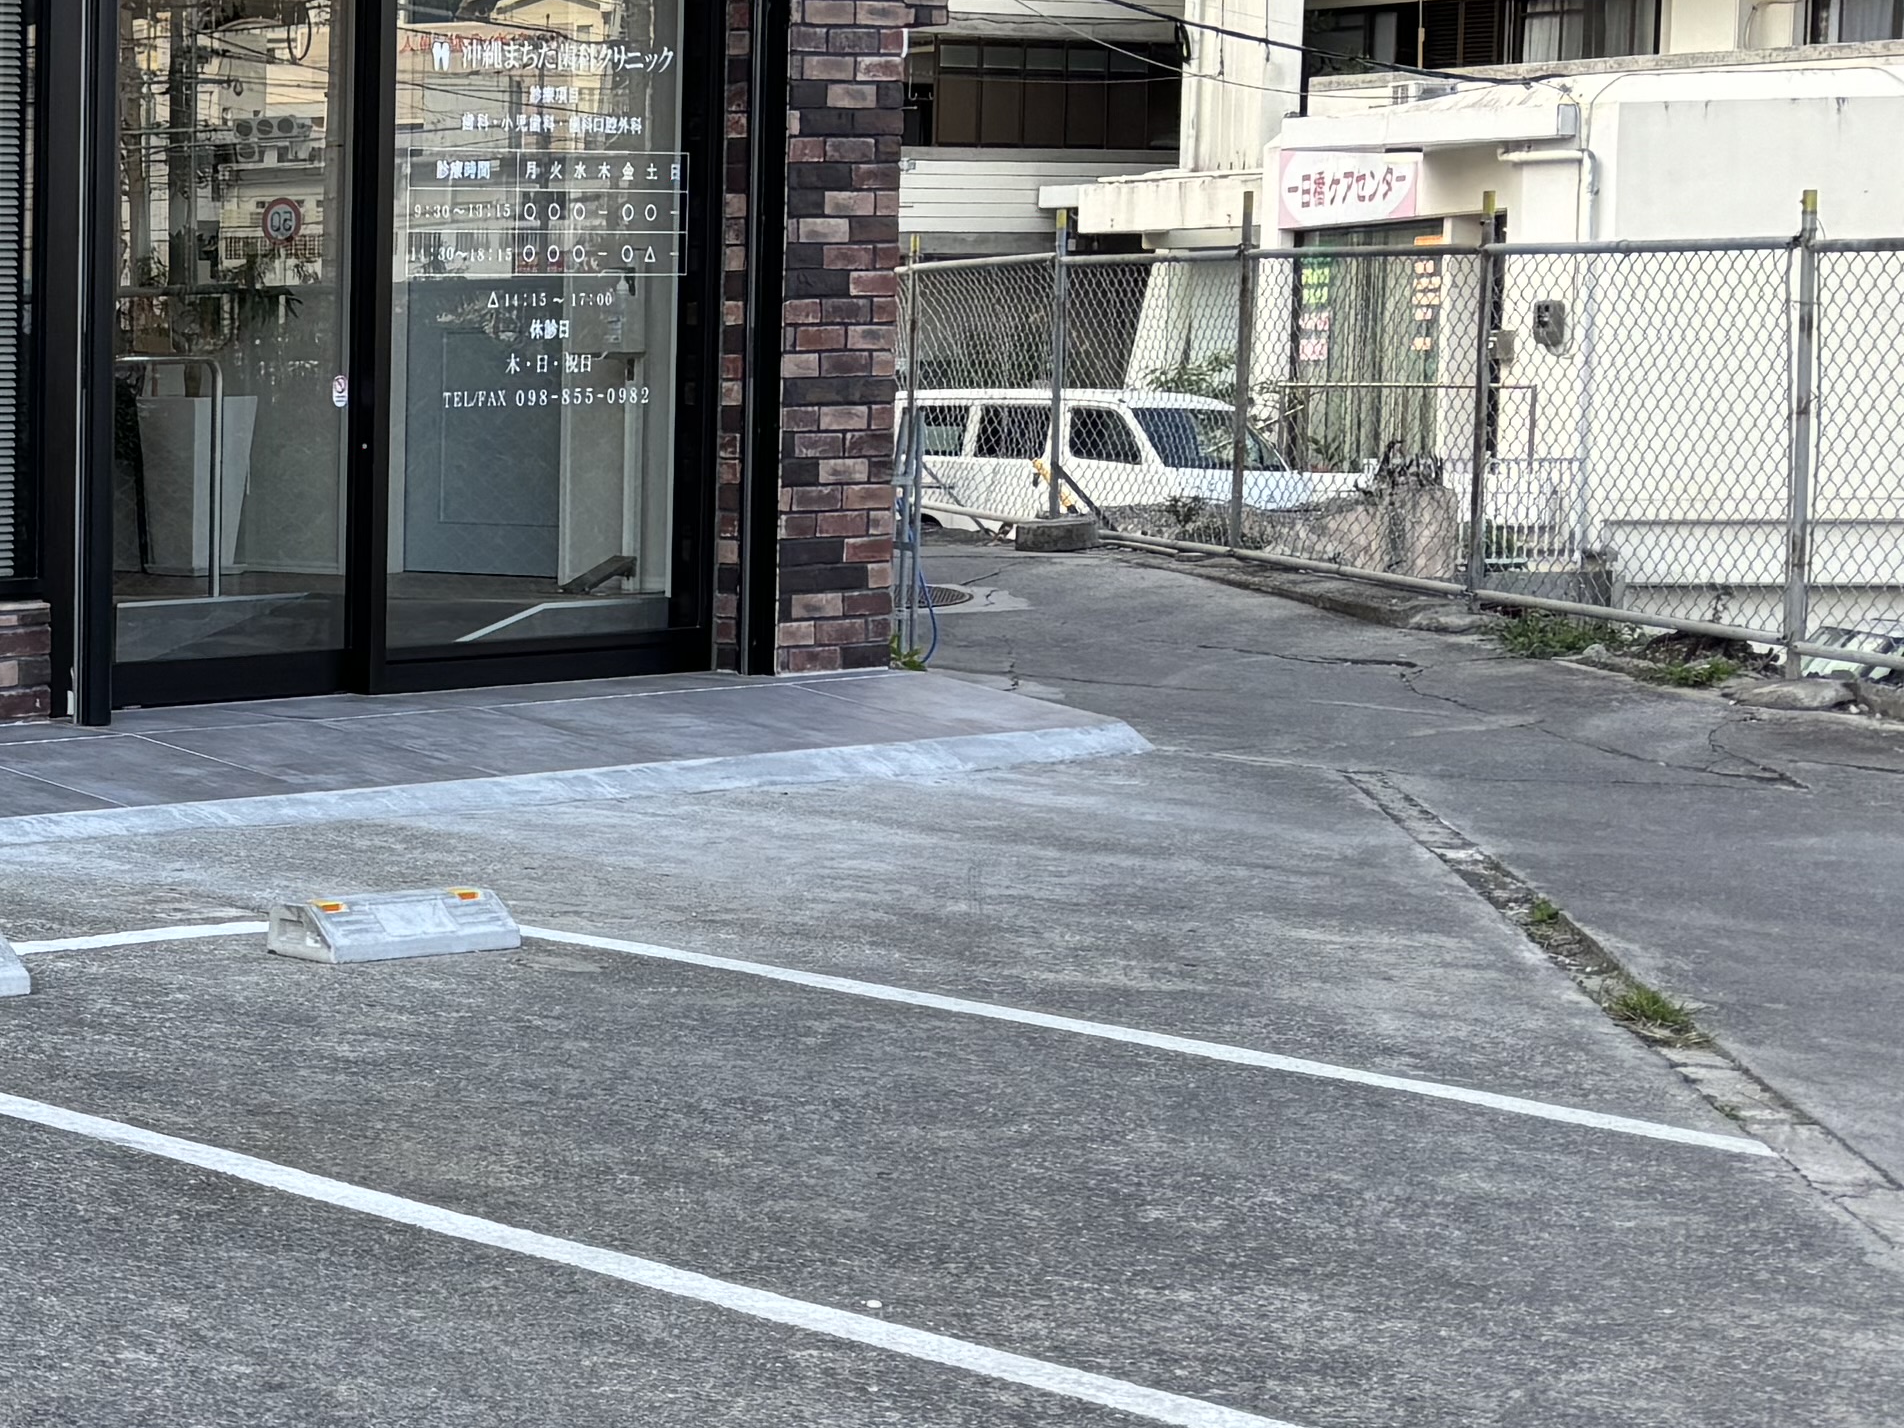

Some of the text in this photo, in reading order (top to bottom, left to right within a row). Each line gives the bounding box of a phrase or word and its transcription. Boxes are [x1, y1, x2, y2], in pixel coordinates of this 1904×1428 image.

[530, 319, 570, 339] 休診日
[443, 387, 650, 408] TEL/FAX 098-855-0982
